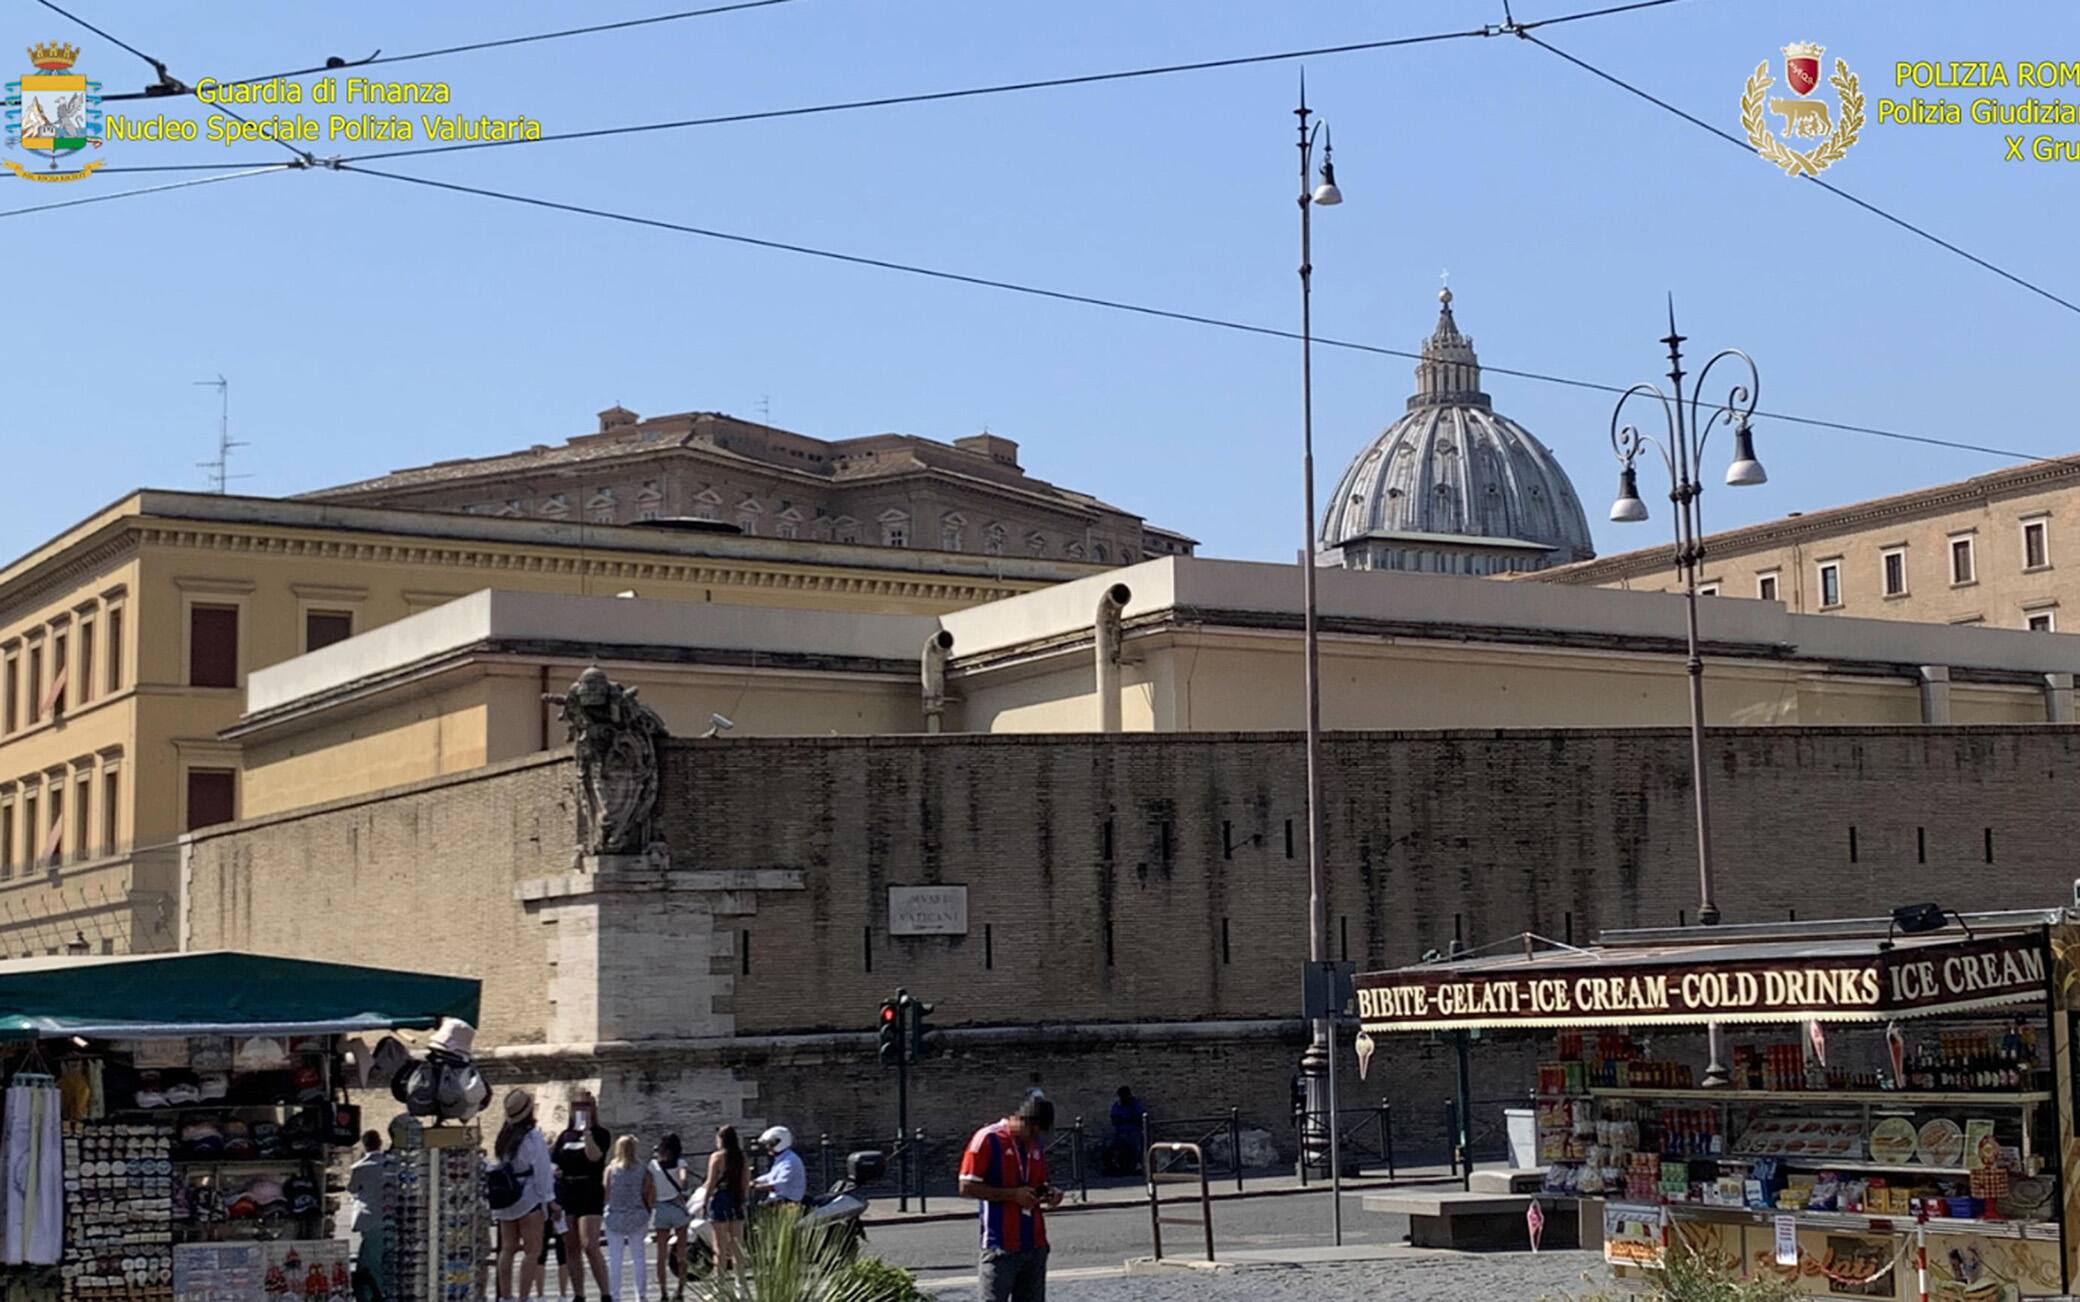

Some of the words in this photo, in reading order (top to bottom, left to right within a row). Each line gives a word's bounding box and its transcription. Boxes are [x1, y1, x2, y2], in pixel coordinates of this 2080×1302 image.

[1763, 968, 1879, 1007] DRINKS
[1888, 960, 1939, 1001] ICE
[1943, 947, 2047, 994] CREAM
